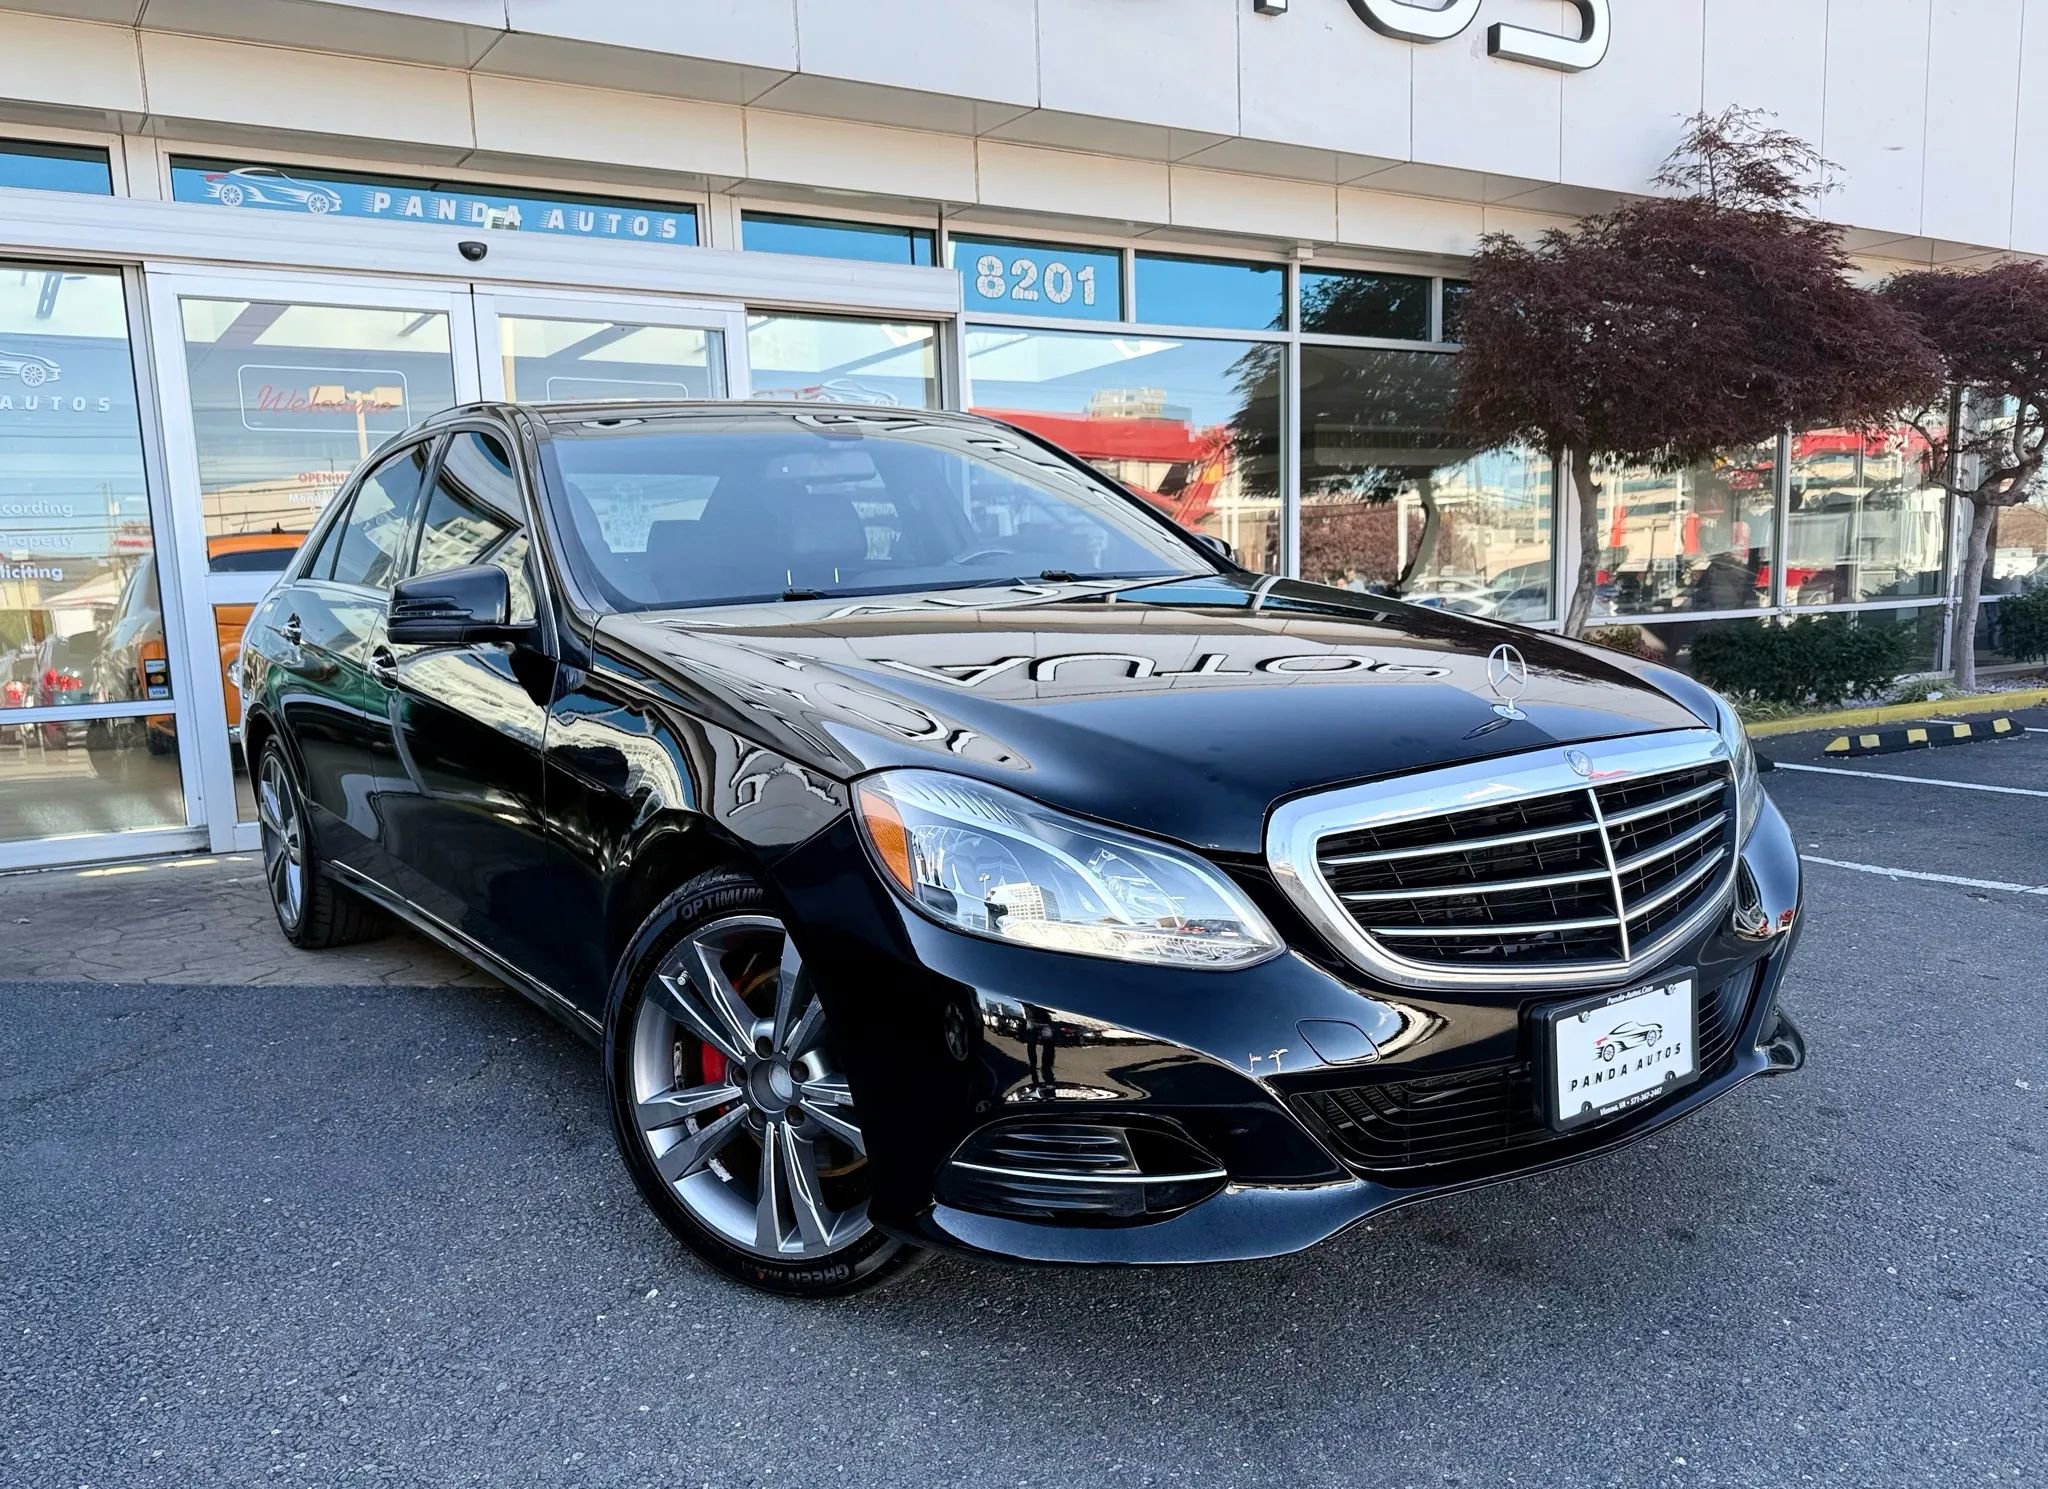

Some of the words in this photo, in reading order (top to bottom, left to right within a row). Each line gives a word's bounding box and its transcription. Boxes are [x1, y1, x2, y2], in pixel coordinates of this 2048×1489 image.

[372, 191, 521, 227] PANDA
[547, 208, 677, 239] AUTOS
[976, 255, 1096, 306] 8201
[0, 395, 111, 412] AUTOS
[257, 385, 393, 414] Welcome
[298, 472, 335, 483] OPEN
[0, 500, 73, 517] cording
[681, 887, 764, 920] OPTIMUM
[1571, 1064, 1628, 1091] PANDA
[1636, 1042, 1681, 1071] AUTOS
[788, 1263, 850, 1285] GREEN
